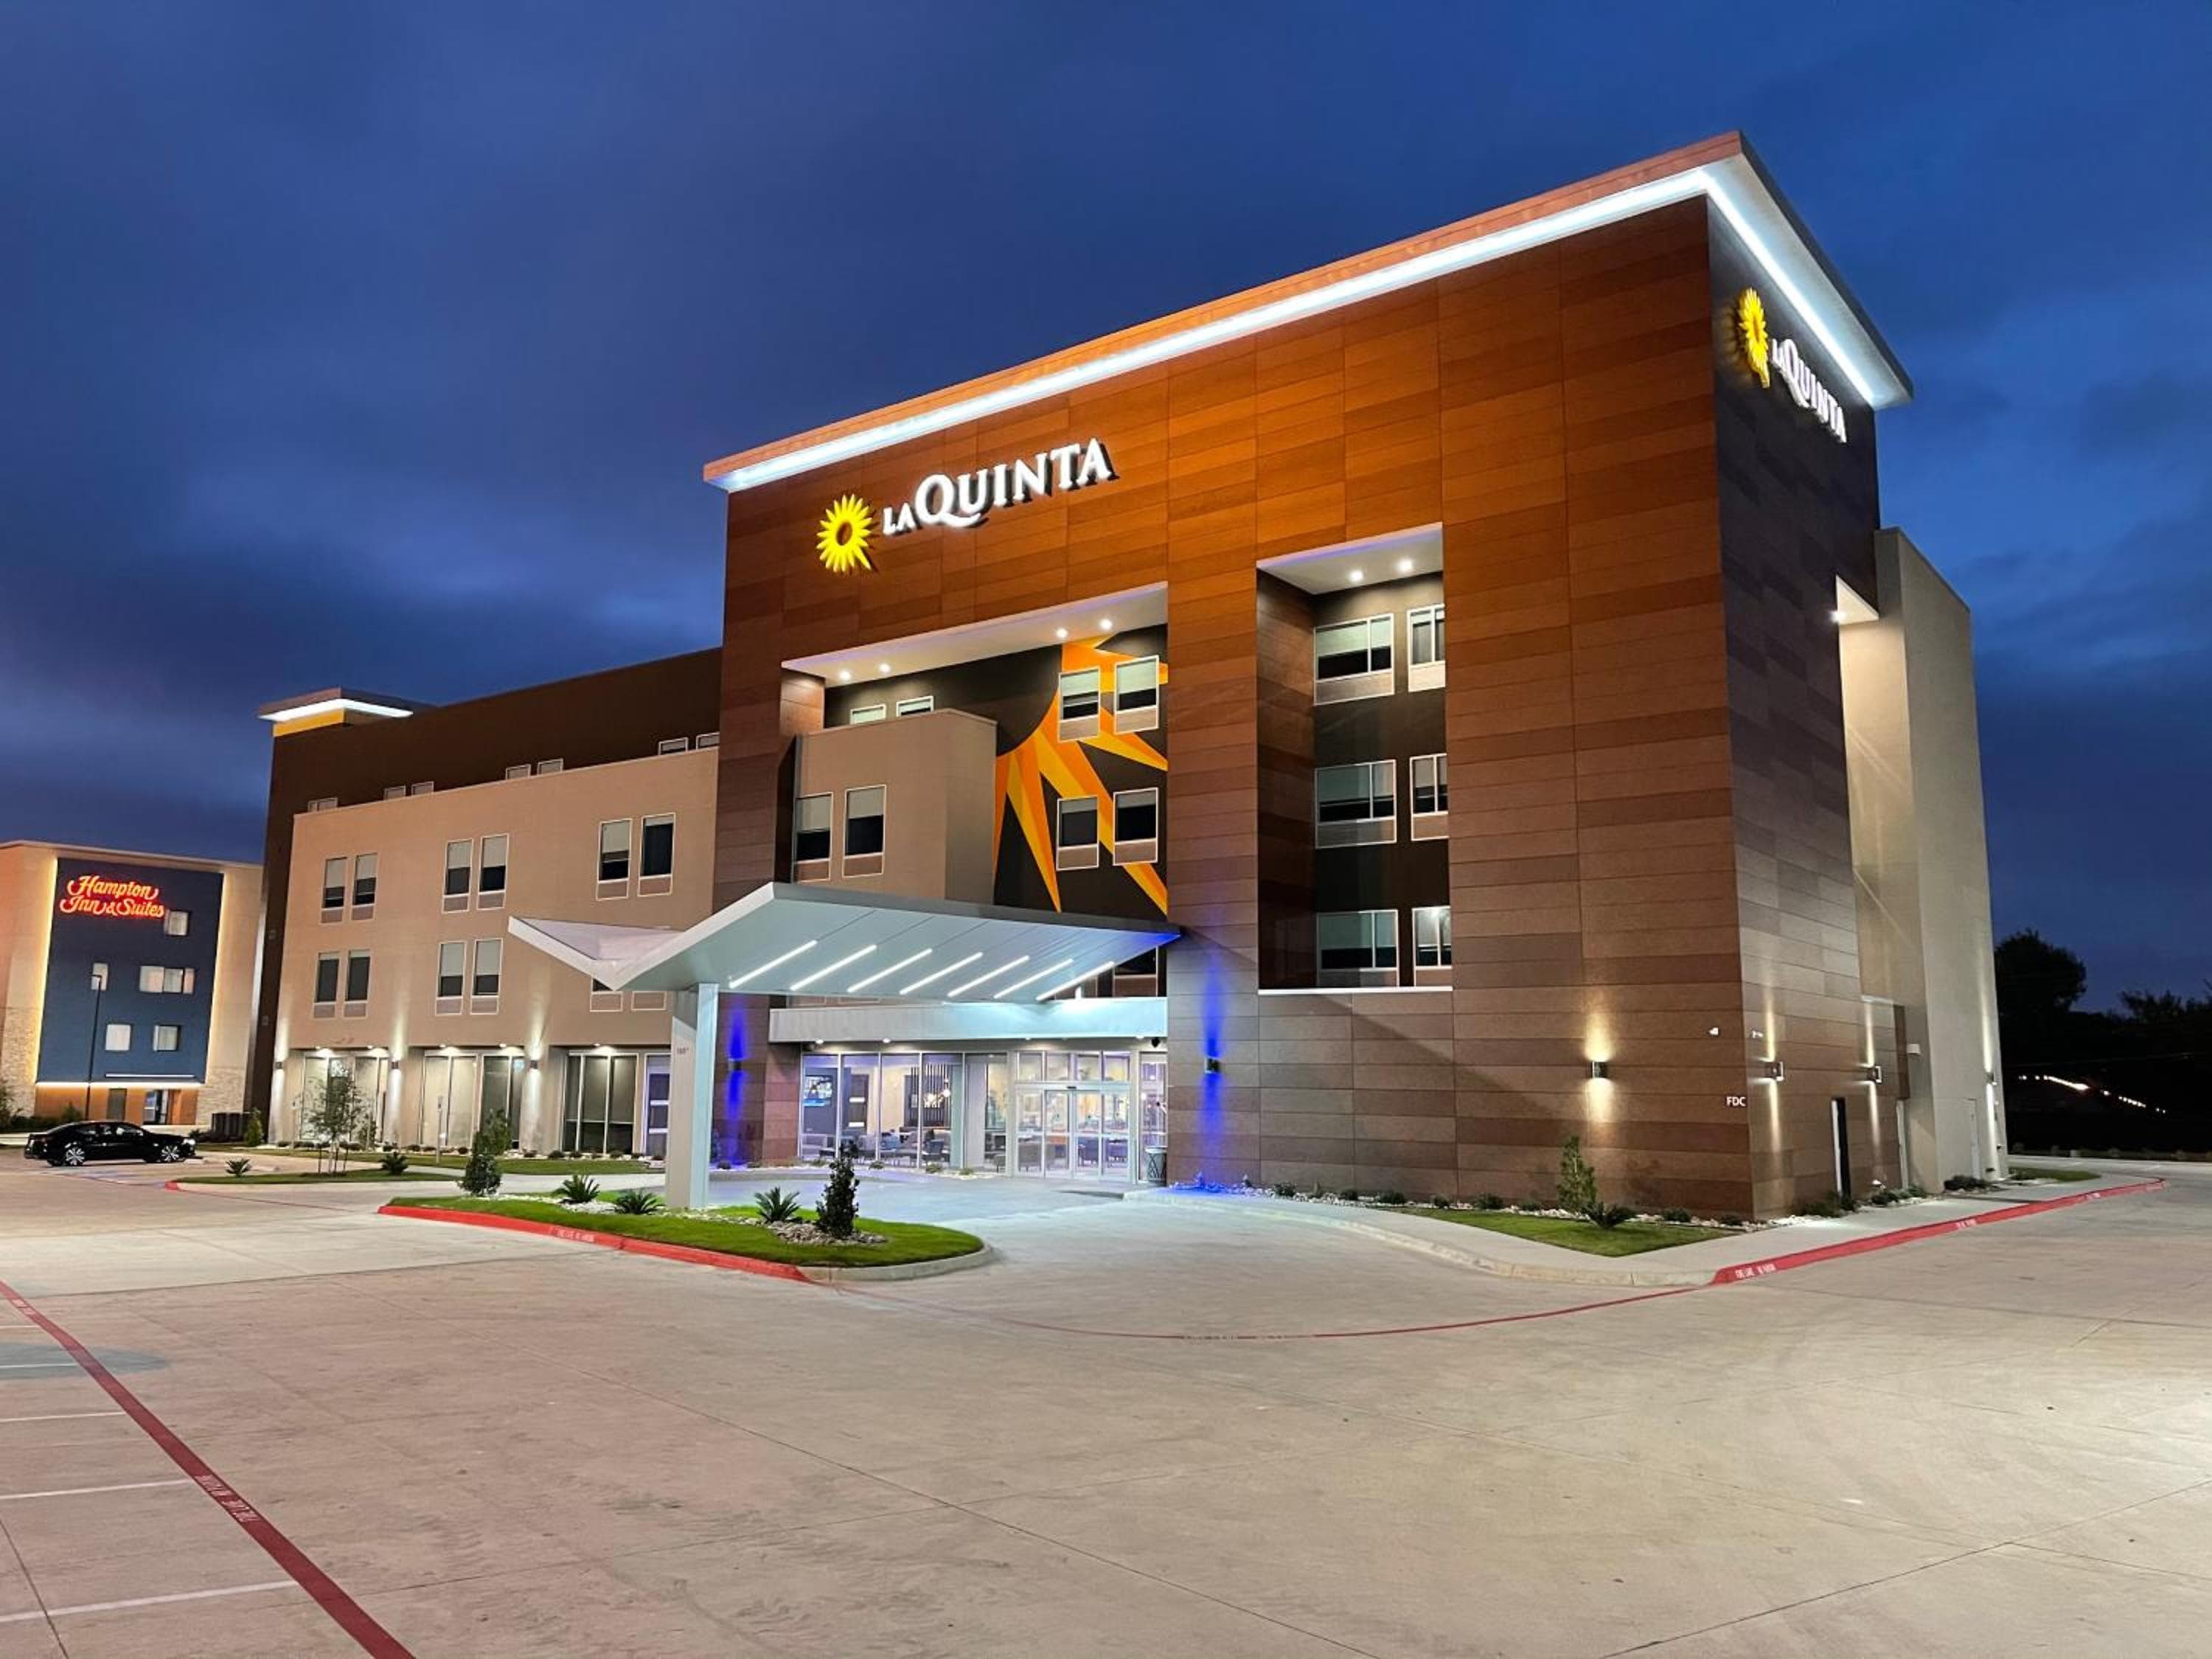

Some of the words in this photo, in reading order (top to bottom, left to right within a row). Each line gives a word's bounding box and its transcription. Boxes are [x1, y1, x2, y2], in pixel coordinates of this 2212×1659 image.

[1780, 338, 1847, 442] QUINTA
[883, 502, 917, 535] LA
[914, 437, 1114, 528] QUINTA
[66, 874, 159, 900] Hampton
[60, 894, 106, 915] Inn
[105, 902, 118, 916] &
[116, 898, 164, 918] Suites
[1726, 1096, 1746, 1106] FDC
